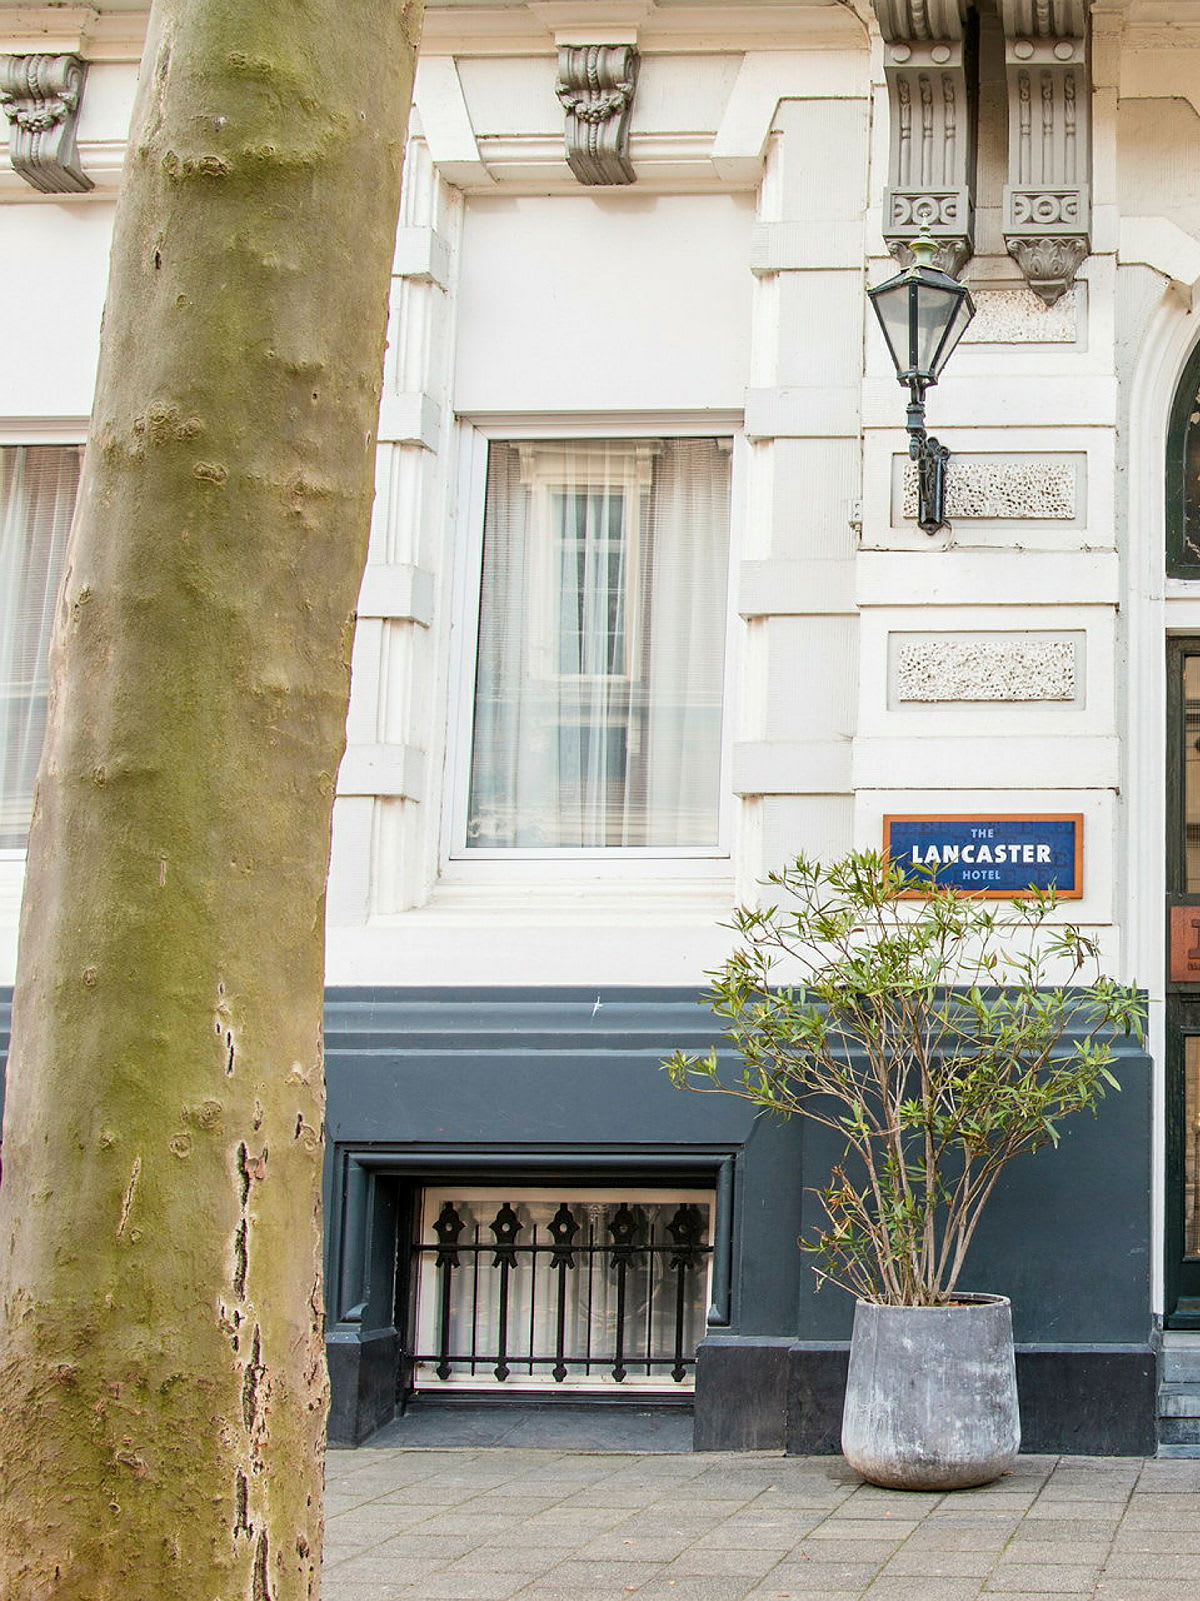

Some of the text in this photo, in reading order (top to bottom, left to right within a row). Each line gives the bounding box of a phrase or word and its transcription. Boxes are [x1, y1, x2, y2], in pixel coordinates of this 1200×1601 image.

[971, 828, 994, 838] THE
[912, 844, 1051, 863] LANCASTER
[962, 870, 1001, 881] HOTEL
